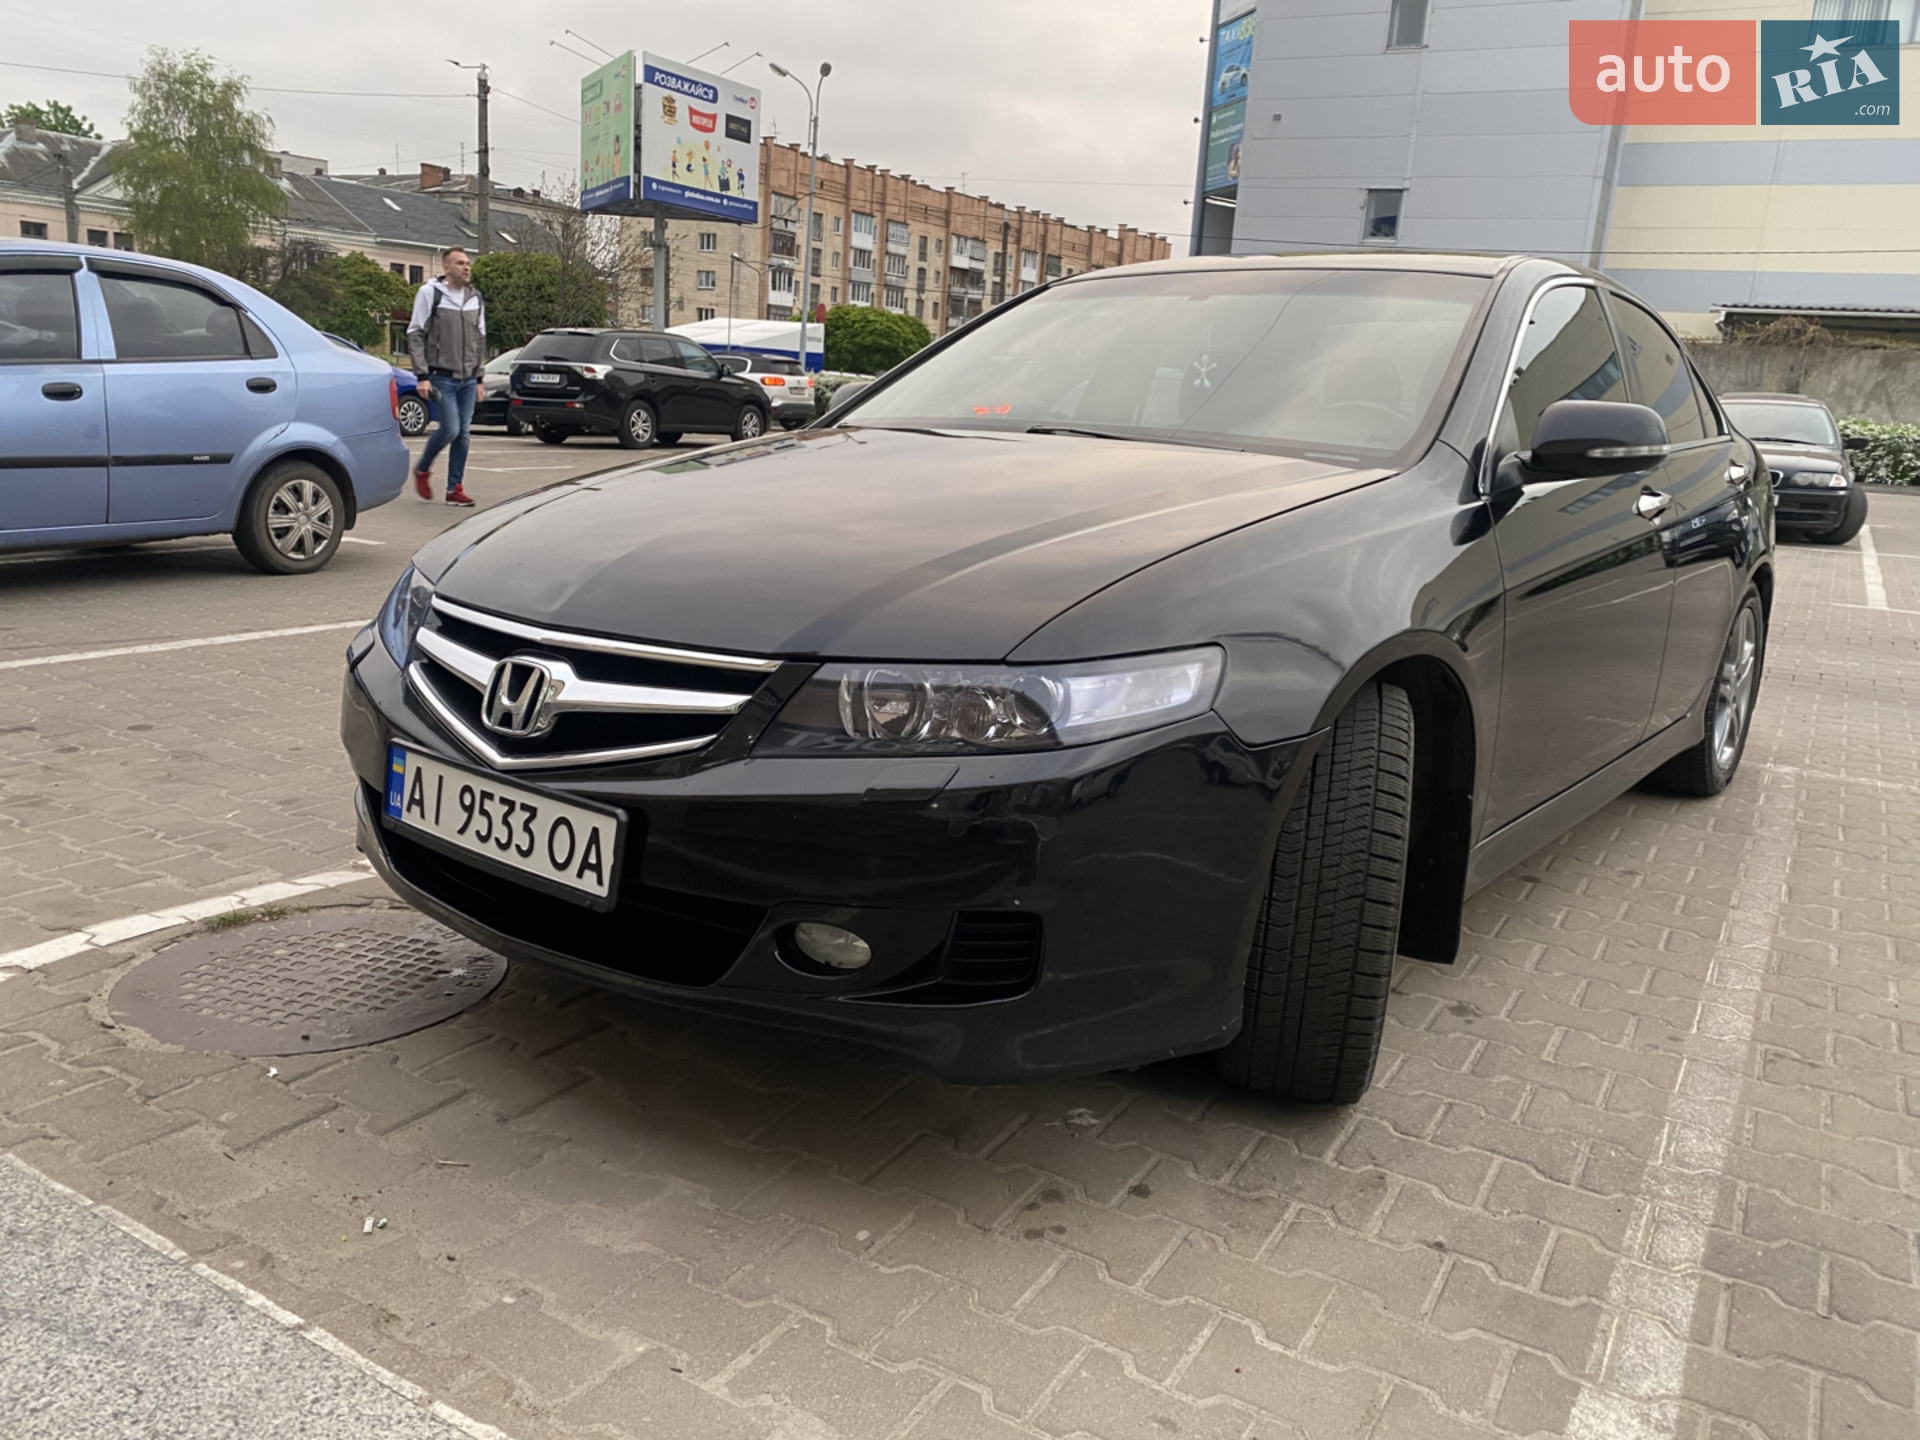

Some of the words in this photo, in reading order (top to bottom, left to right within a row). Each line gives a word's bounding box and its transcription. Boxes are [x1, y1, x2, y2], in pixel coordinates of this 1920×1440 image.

[653, 71, 714, 101] РОЗВАЖАЙСЯ
[390, 790, 402, 809] UA
[406, 766, 444, 826] AI
[457, 784, 538, 858] 9533
[547, 815, 604, 887] OA
